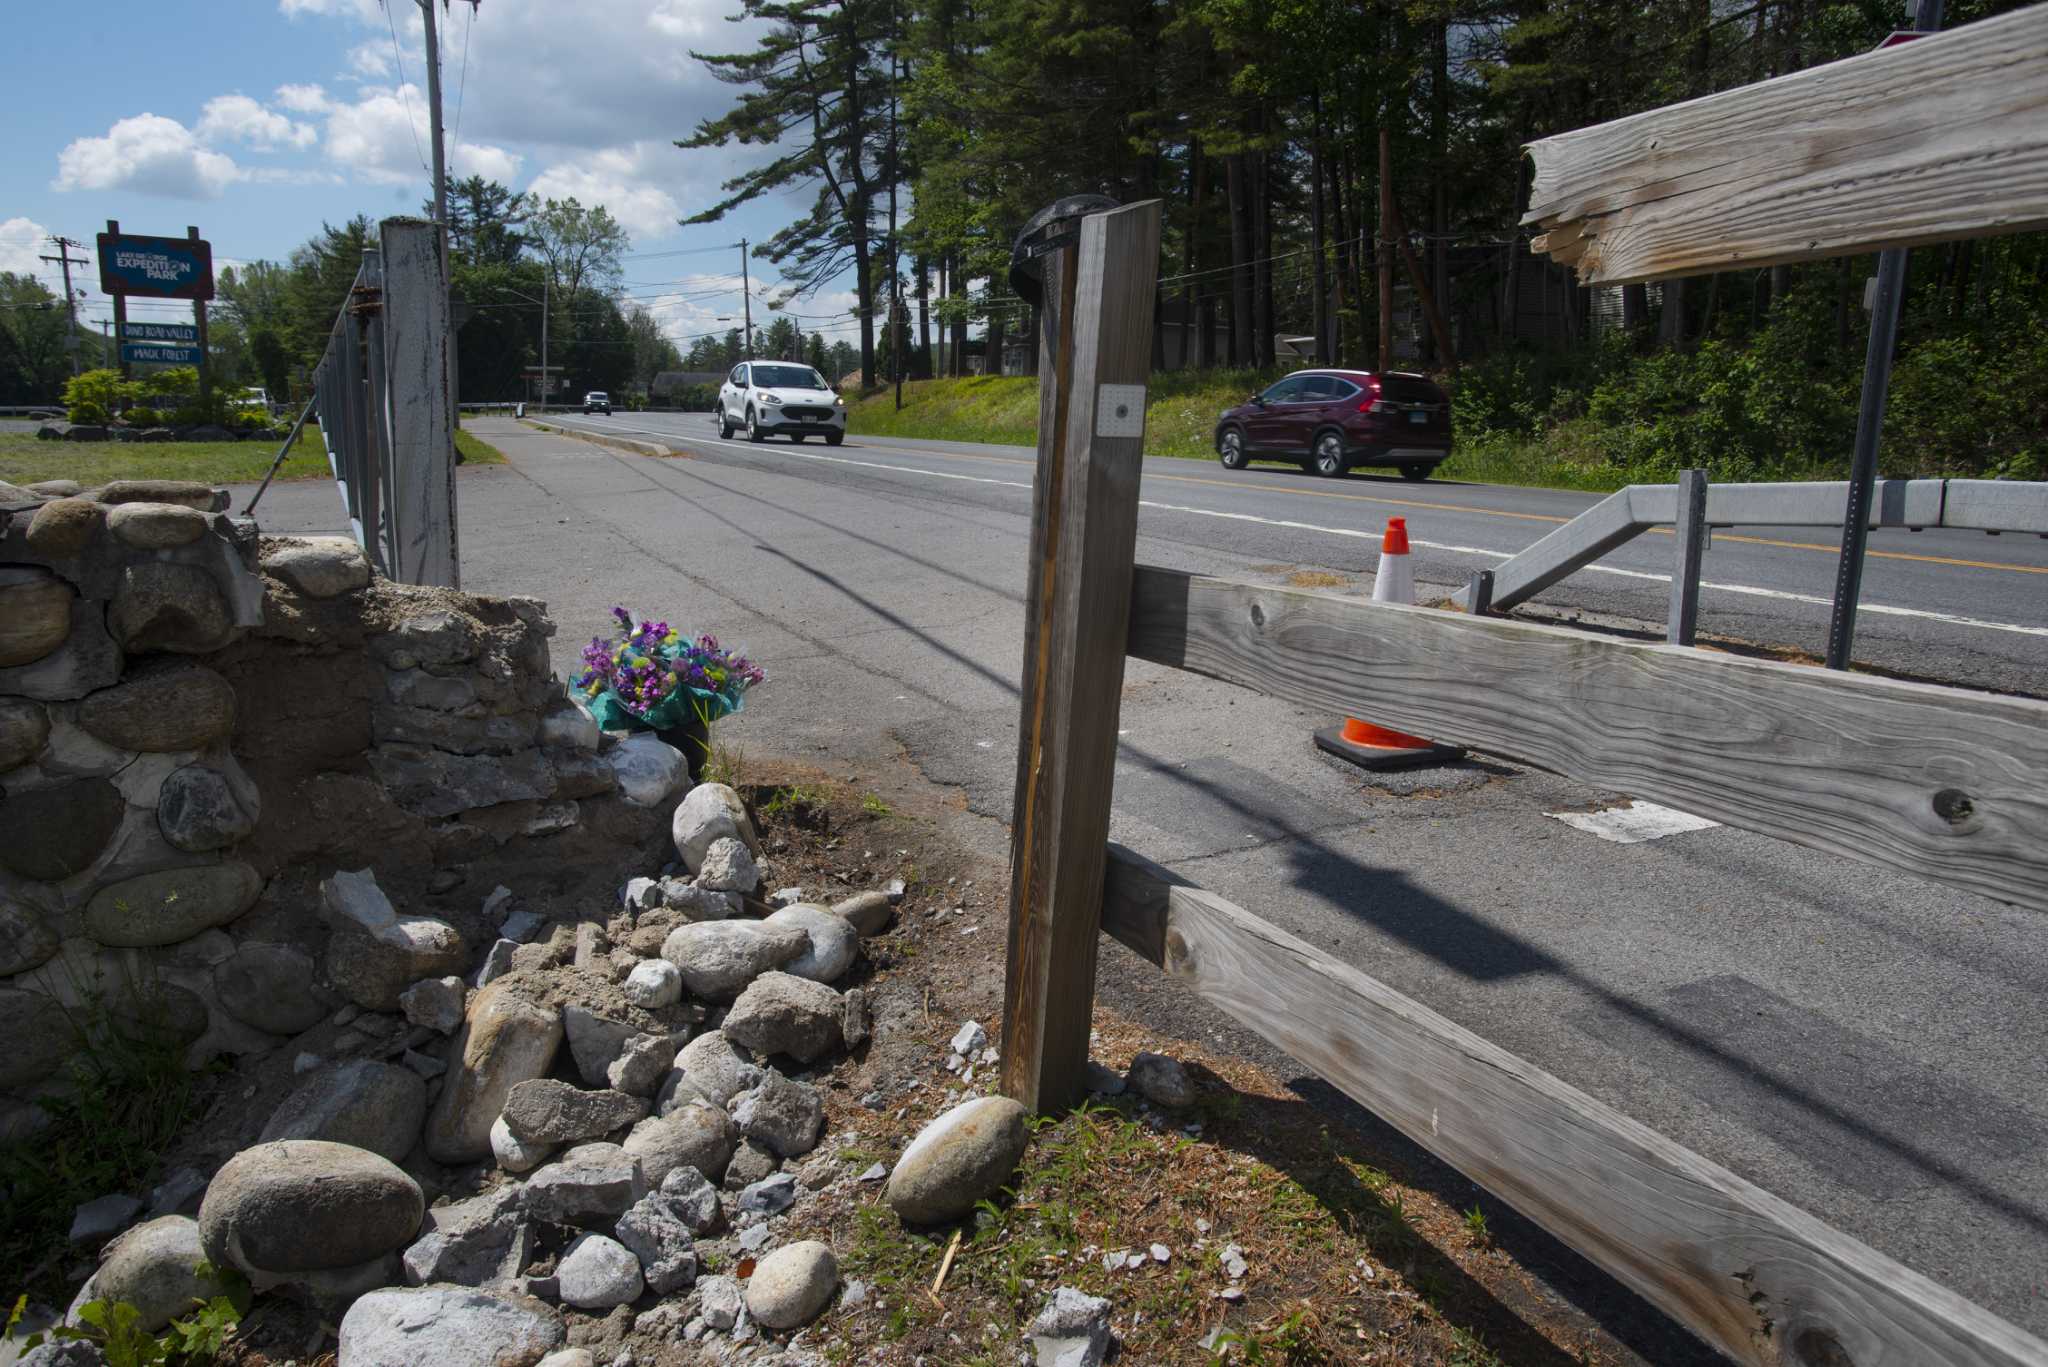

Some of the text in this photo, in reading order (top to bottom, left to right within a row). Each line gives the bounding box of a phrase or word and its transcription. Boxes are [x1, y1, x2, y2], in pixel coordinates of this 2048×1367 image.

[116, 258, 191, 272] EXPEDITION
[146, 269, 179, 280] PARK
[166, 327, 193, 339] VALLEY
